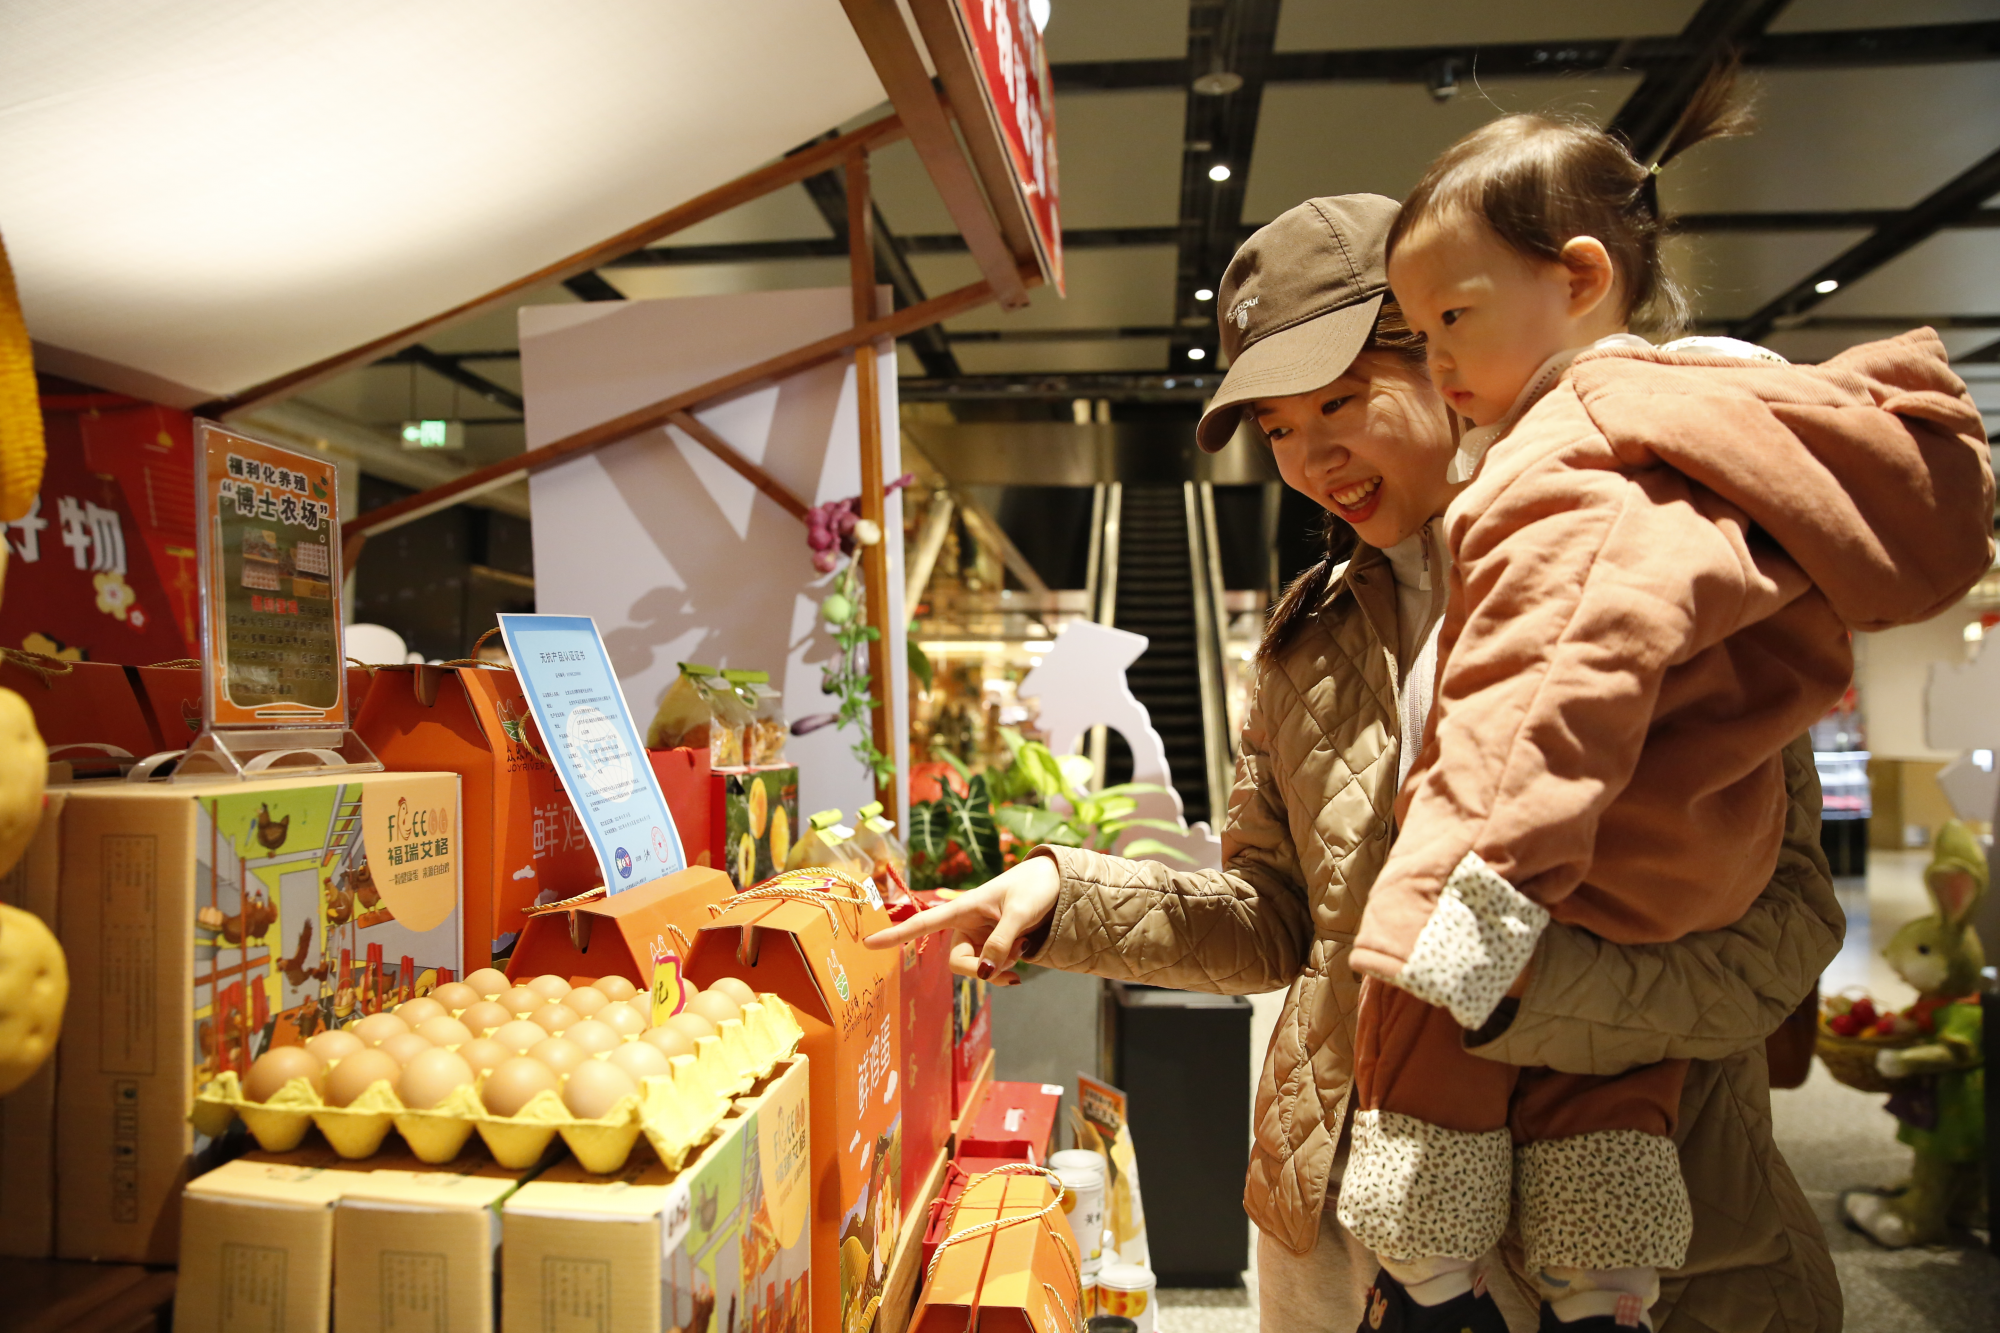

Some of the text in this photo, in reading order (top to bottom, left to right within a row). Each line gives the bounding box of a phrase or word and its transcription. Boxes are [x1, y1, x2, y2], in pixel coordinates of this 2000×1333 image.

[227, 455, 308, 494] 福利化养殖
[507, 762, 545, 773] JOYRIVER
[387, 838, 448, 866] 福瑞艾格
[858, 1013, 890, 1120] 鲜鸡蛋
